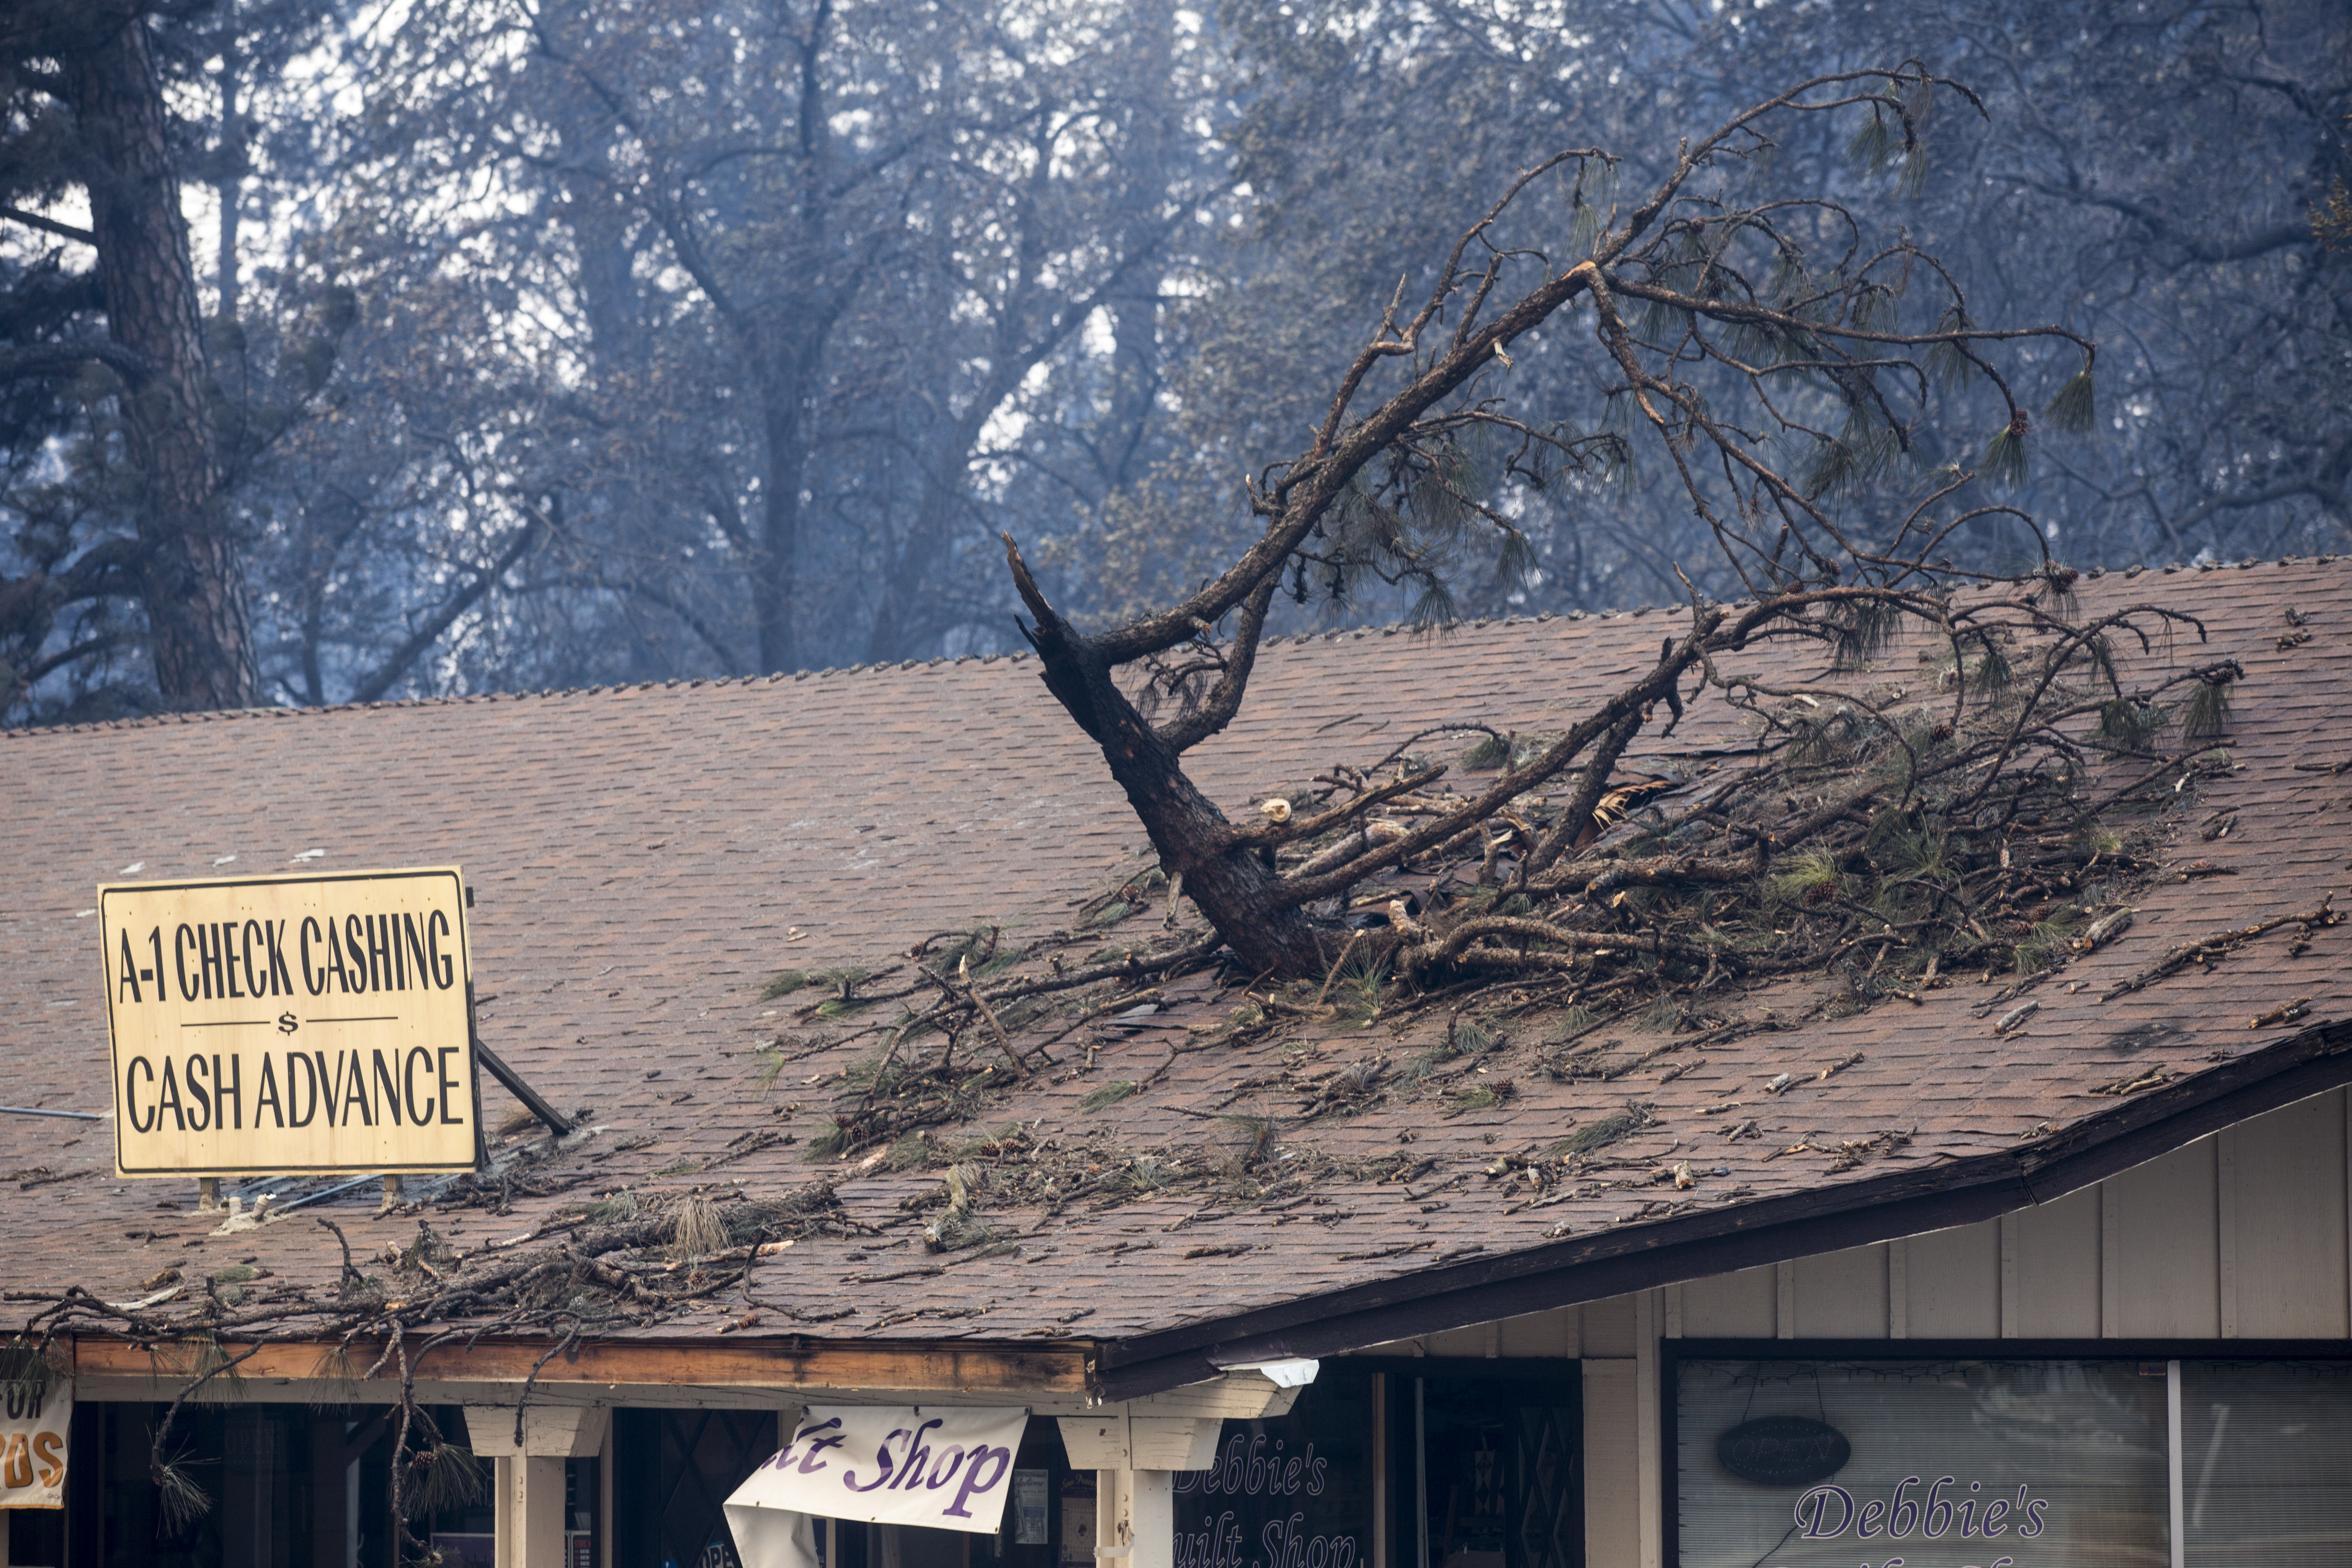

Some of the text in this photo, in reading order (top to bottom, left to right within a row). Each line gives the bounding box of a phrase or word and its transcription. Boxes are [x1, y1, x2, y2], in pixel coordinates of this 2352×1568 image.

[120, 909, 454, 1004] A-1 CHECK CASHING
[278, 1011, 298, 1036] $
[127, 1046, 464, 1134] CASH ADVANCE
[0, 1381, 46, 1419] OR
[843, 1418, 1011, 1519] Shop
[1733, 1436, 1833, 1461] OPEN
[1794, 1476, 2048, 1539] Debbie's
[1252, 1512, 1355, 1568] Shop
